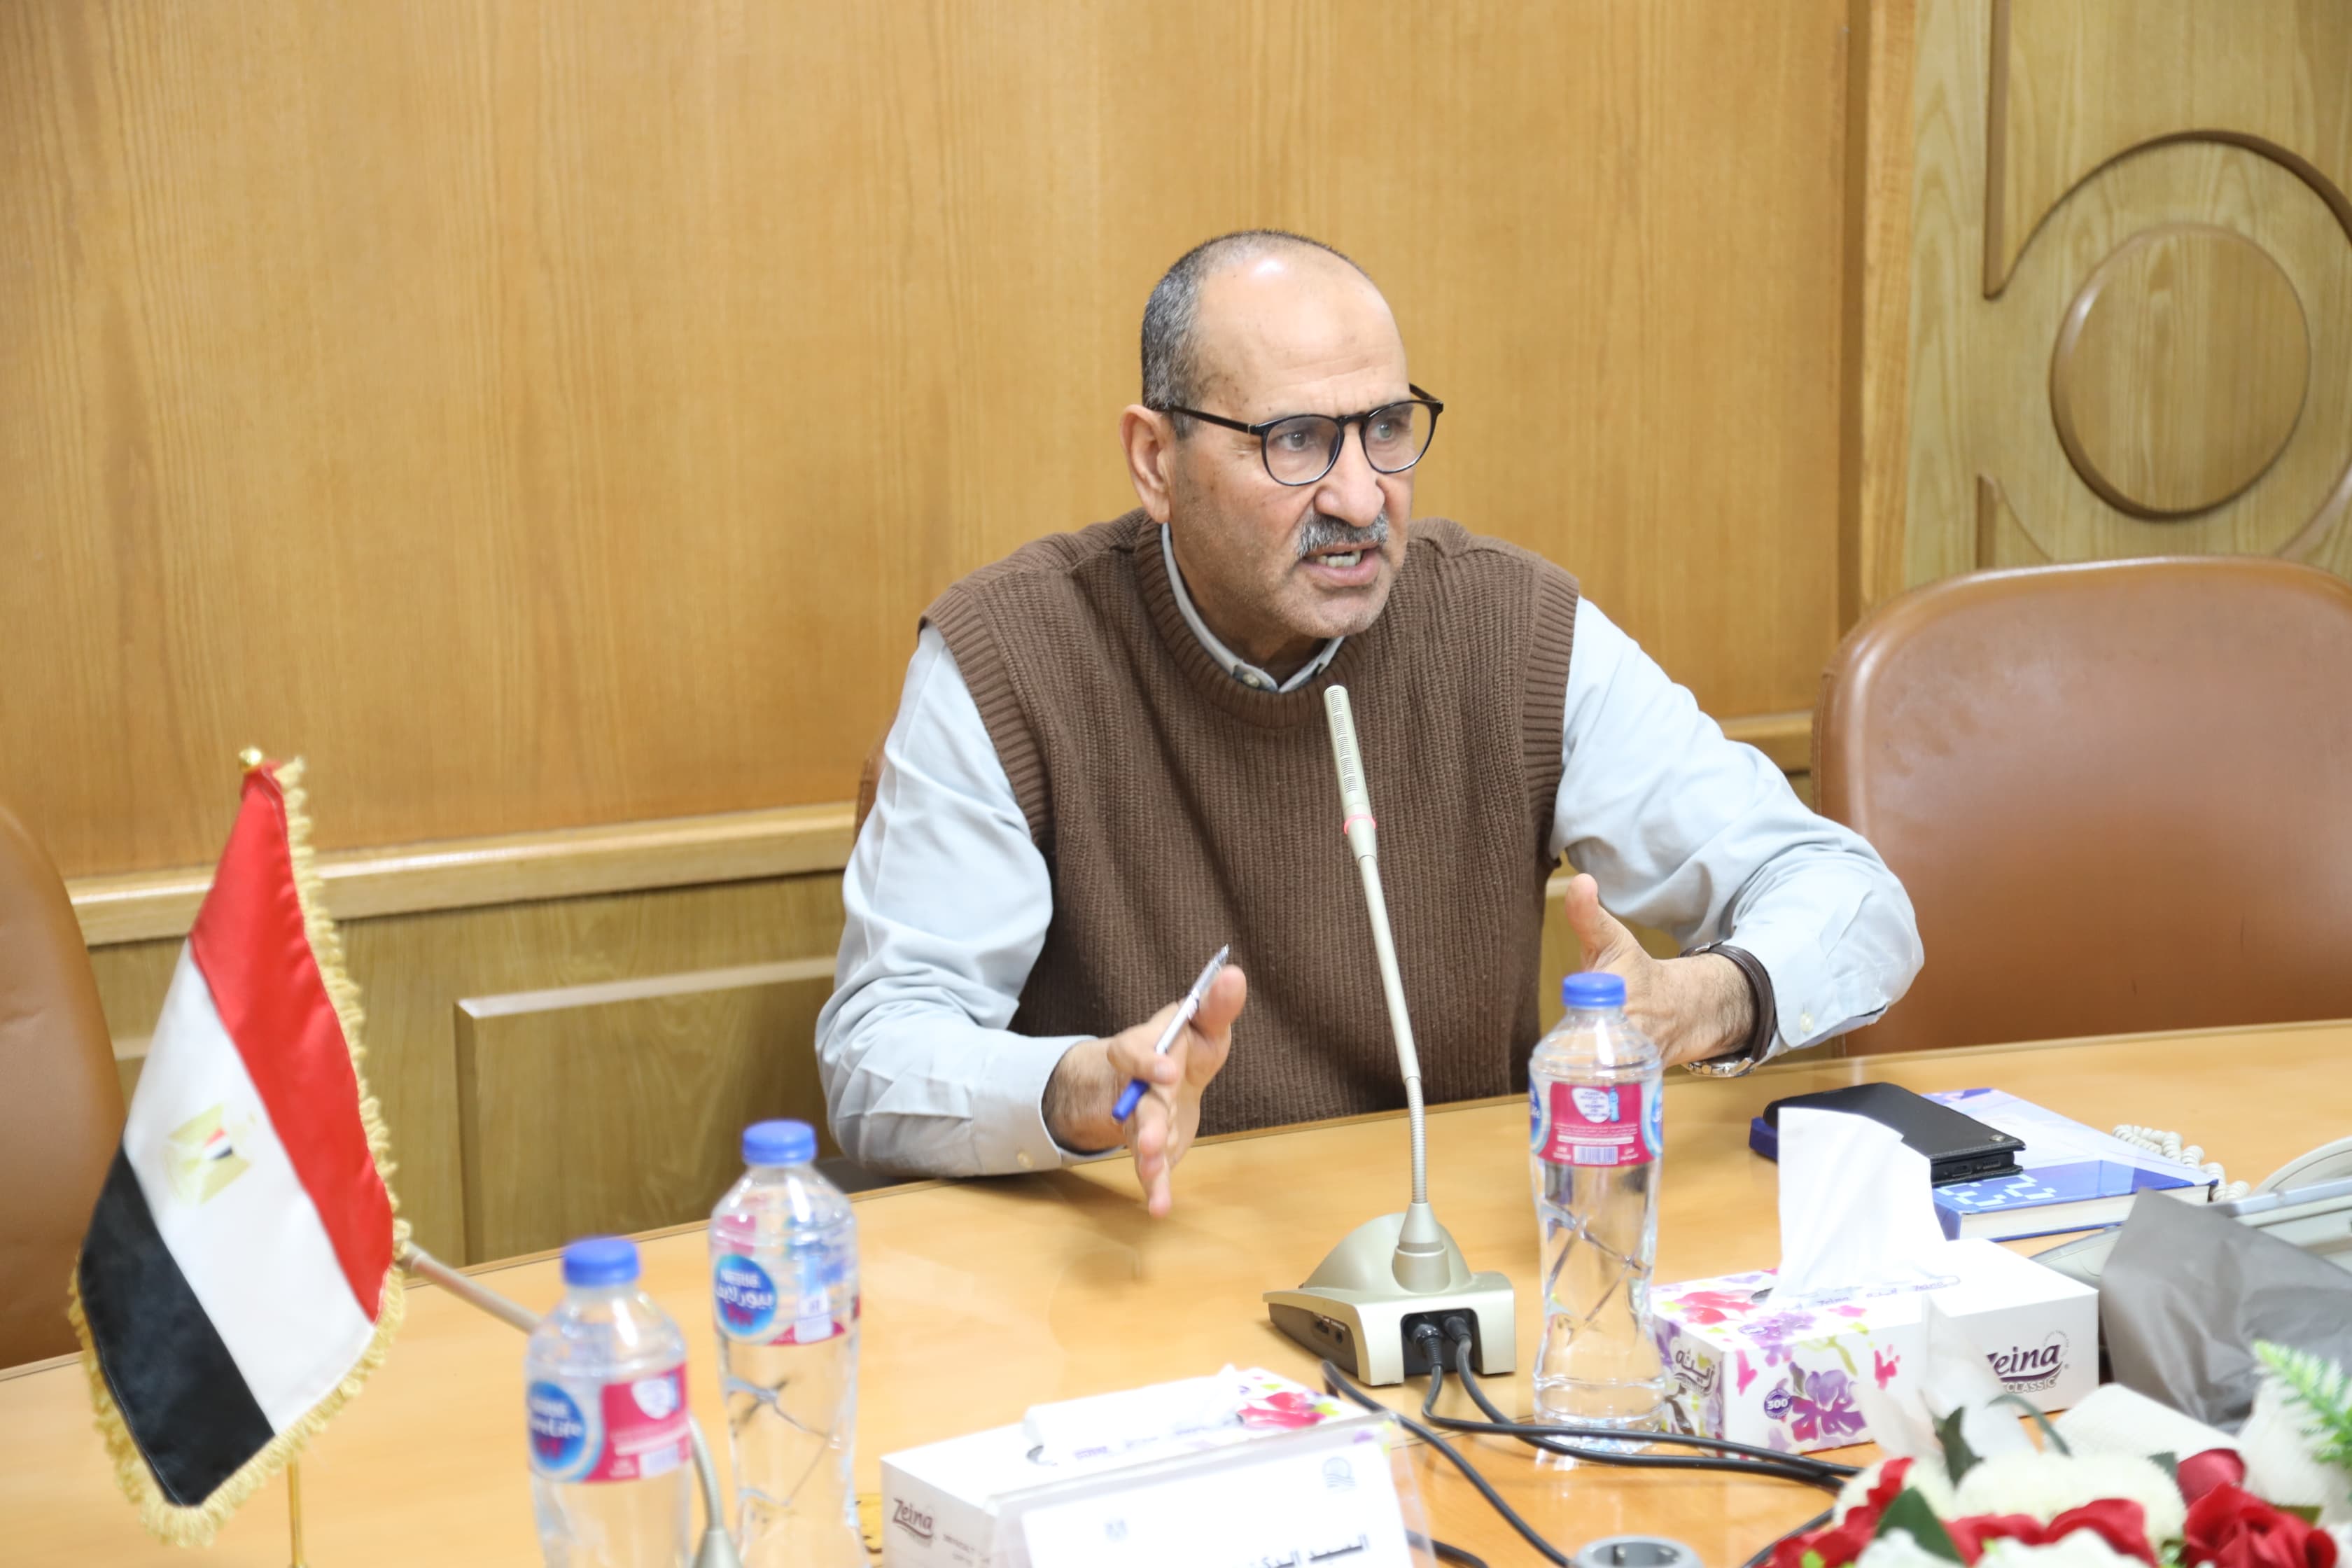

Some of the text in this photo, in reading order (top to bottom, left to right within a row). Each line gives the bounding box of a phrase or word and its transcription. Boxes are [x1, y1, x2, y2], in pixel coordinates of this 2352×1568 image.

[2004, 1376, 2057, 1394] CLASSIC
[1767, 1399, 1788, 1410] 300
[892, 1497, 933, 1539] Zeina
